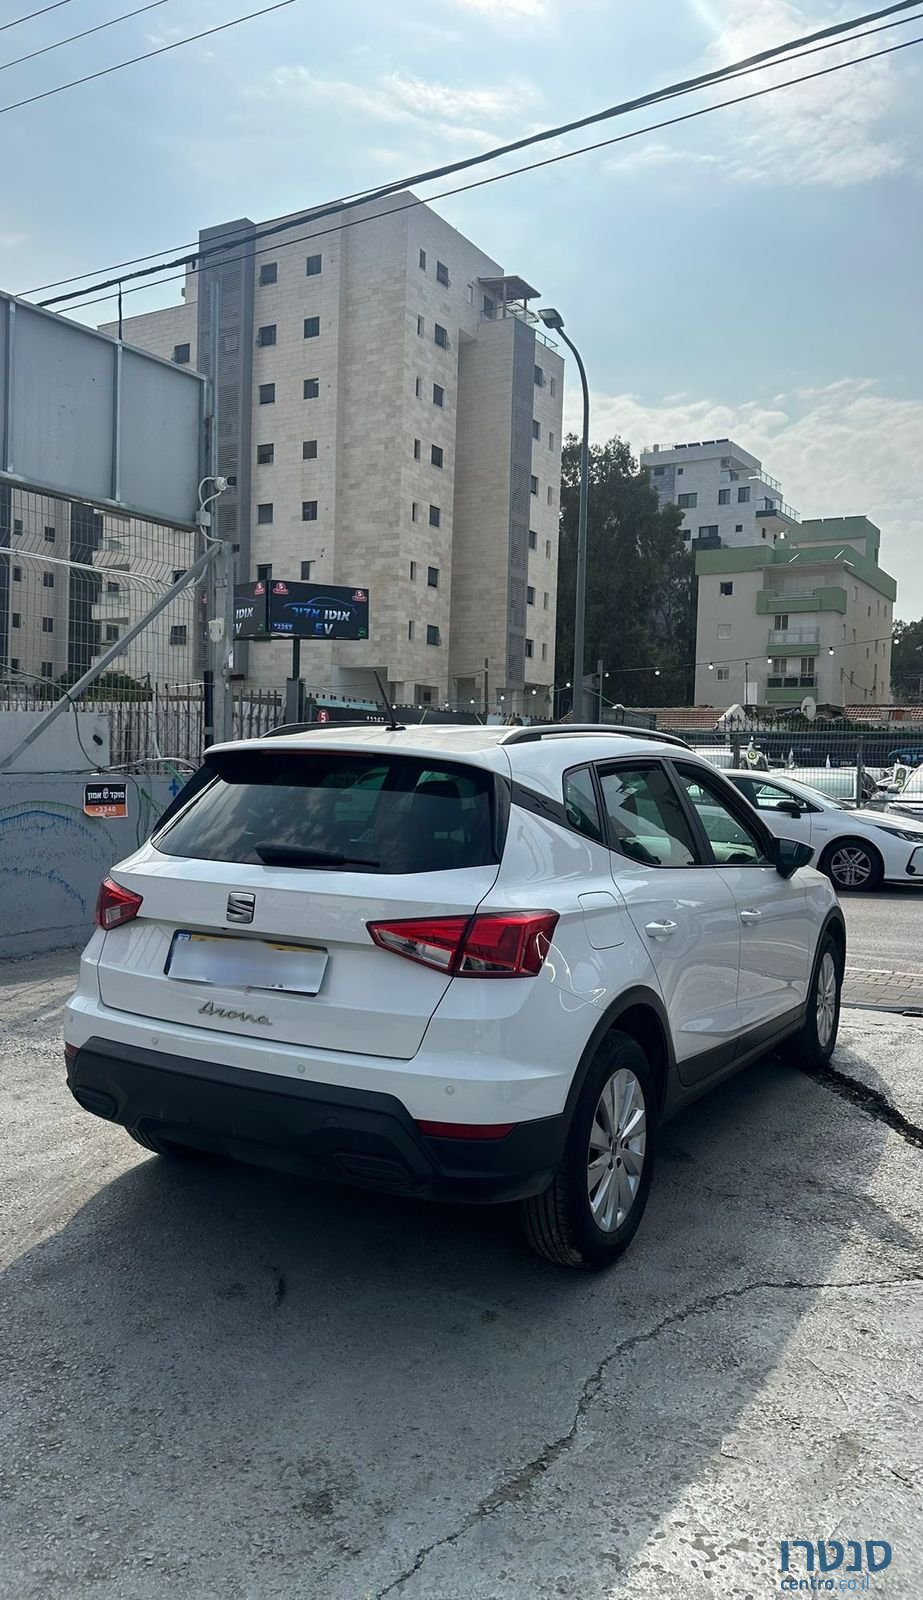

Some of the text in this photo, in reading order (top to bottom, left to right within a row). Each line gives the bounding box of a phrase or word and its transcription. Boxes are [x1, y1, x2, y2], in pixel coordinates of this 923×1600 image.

[291, 607, 351, 621] אוטו אדיר
[315, 622, 334, 635] EV
[88, 791, 124, 800] מוקד אמון
[197, 1000, 274, 1026] Arona
